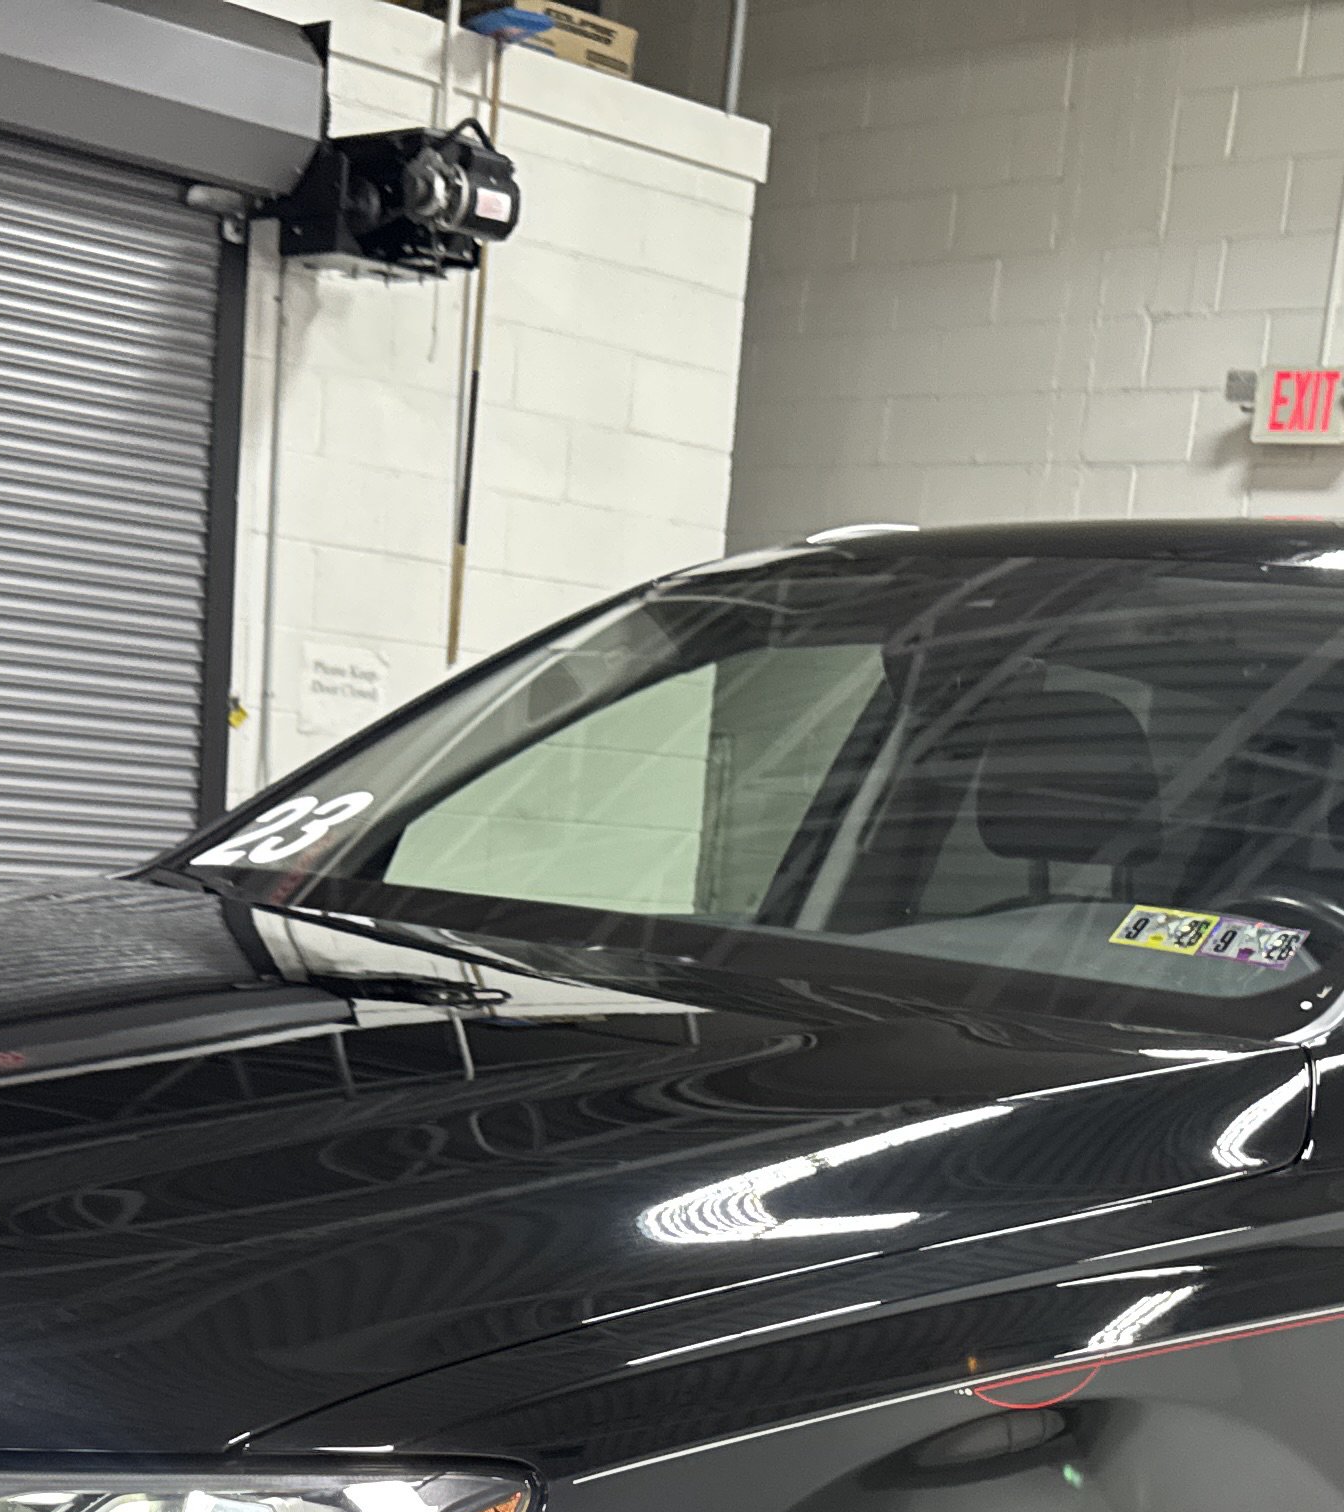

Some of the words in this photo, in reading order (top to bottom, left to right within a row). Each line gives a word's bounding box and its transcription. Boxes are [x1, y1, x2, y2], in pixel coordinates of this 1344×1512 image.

[1267, 370, 1342, 432] EXIT
[190, 791, 374, 866] 23
[1125, 917, 1150, 940] 9
[1213, 929, 1238, 953] 9
